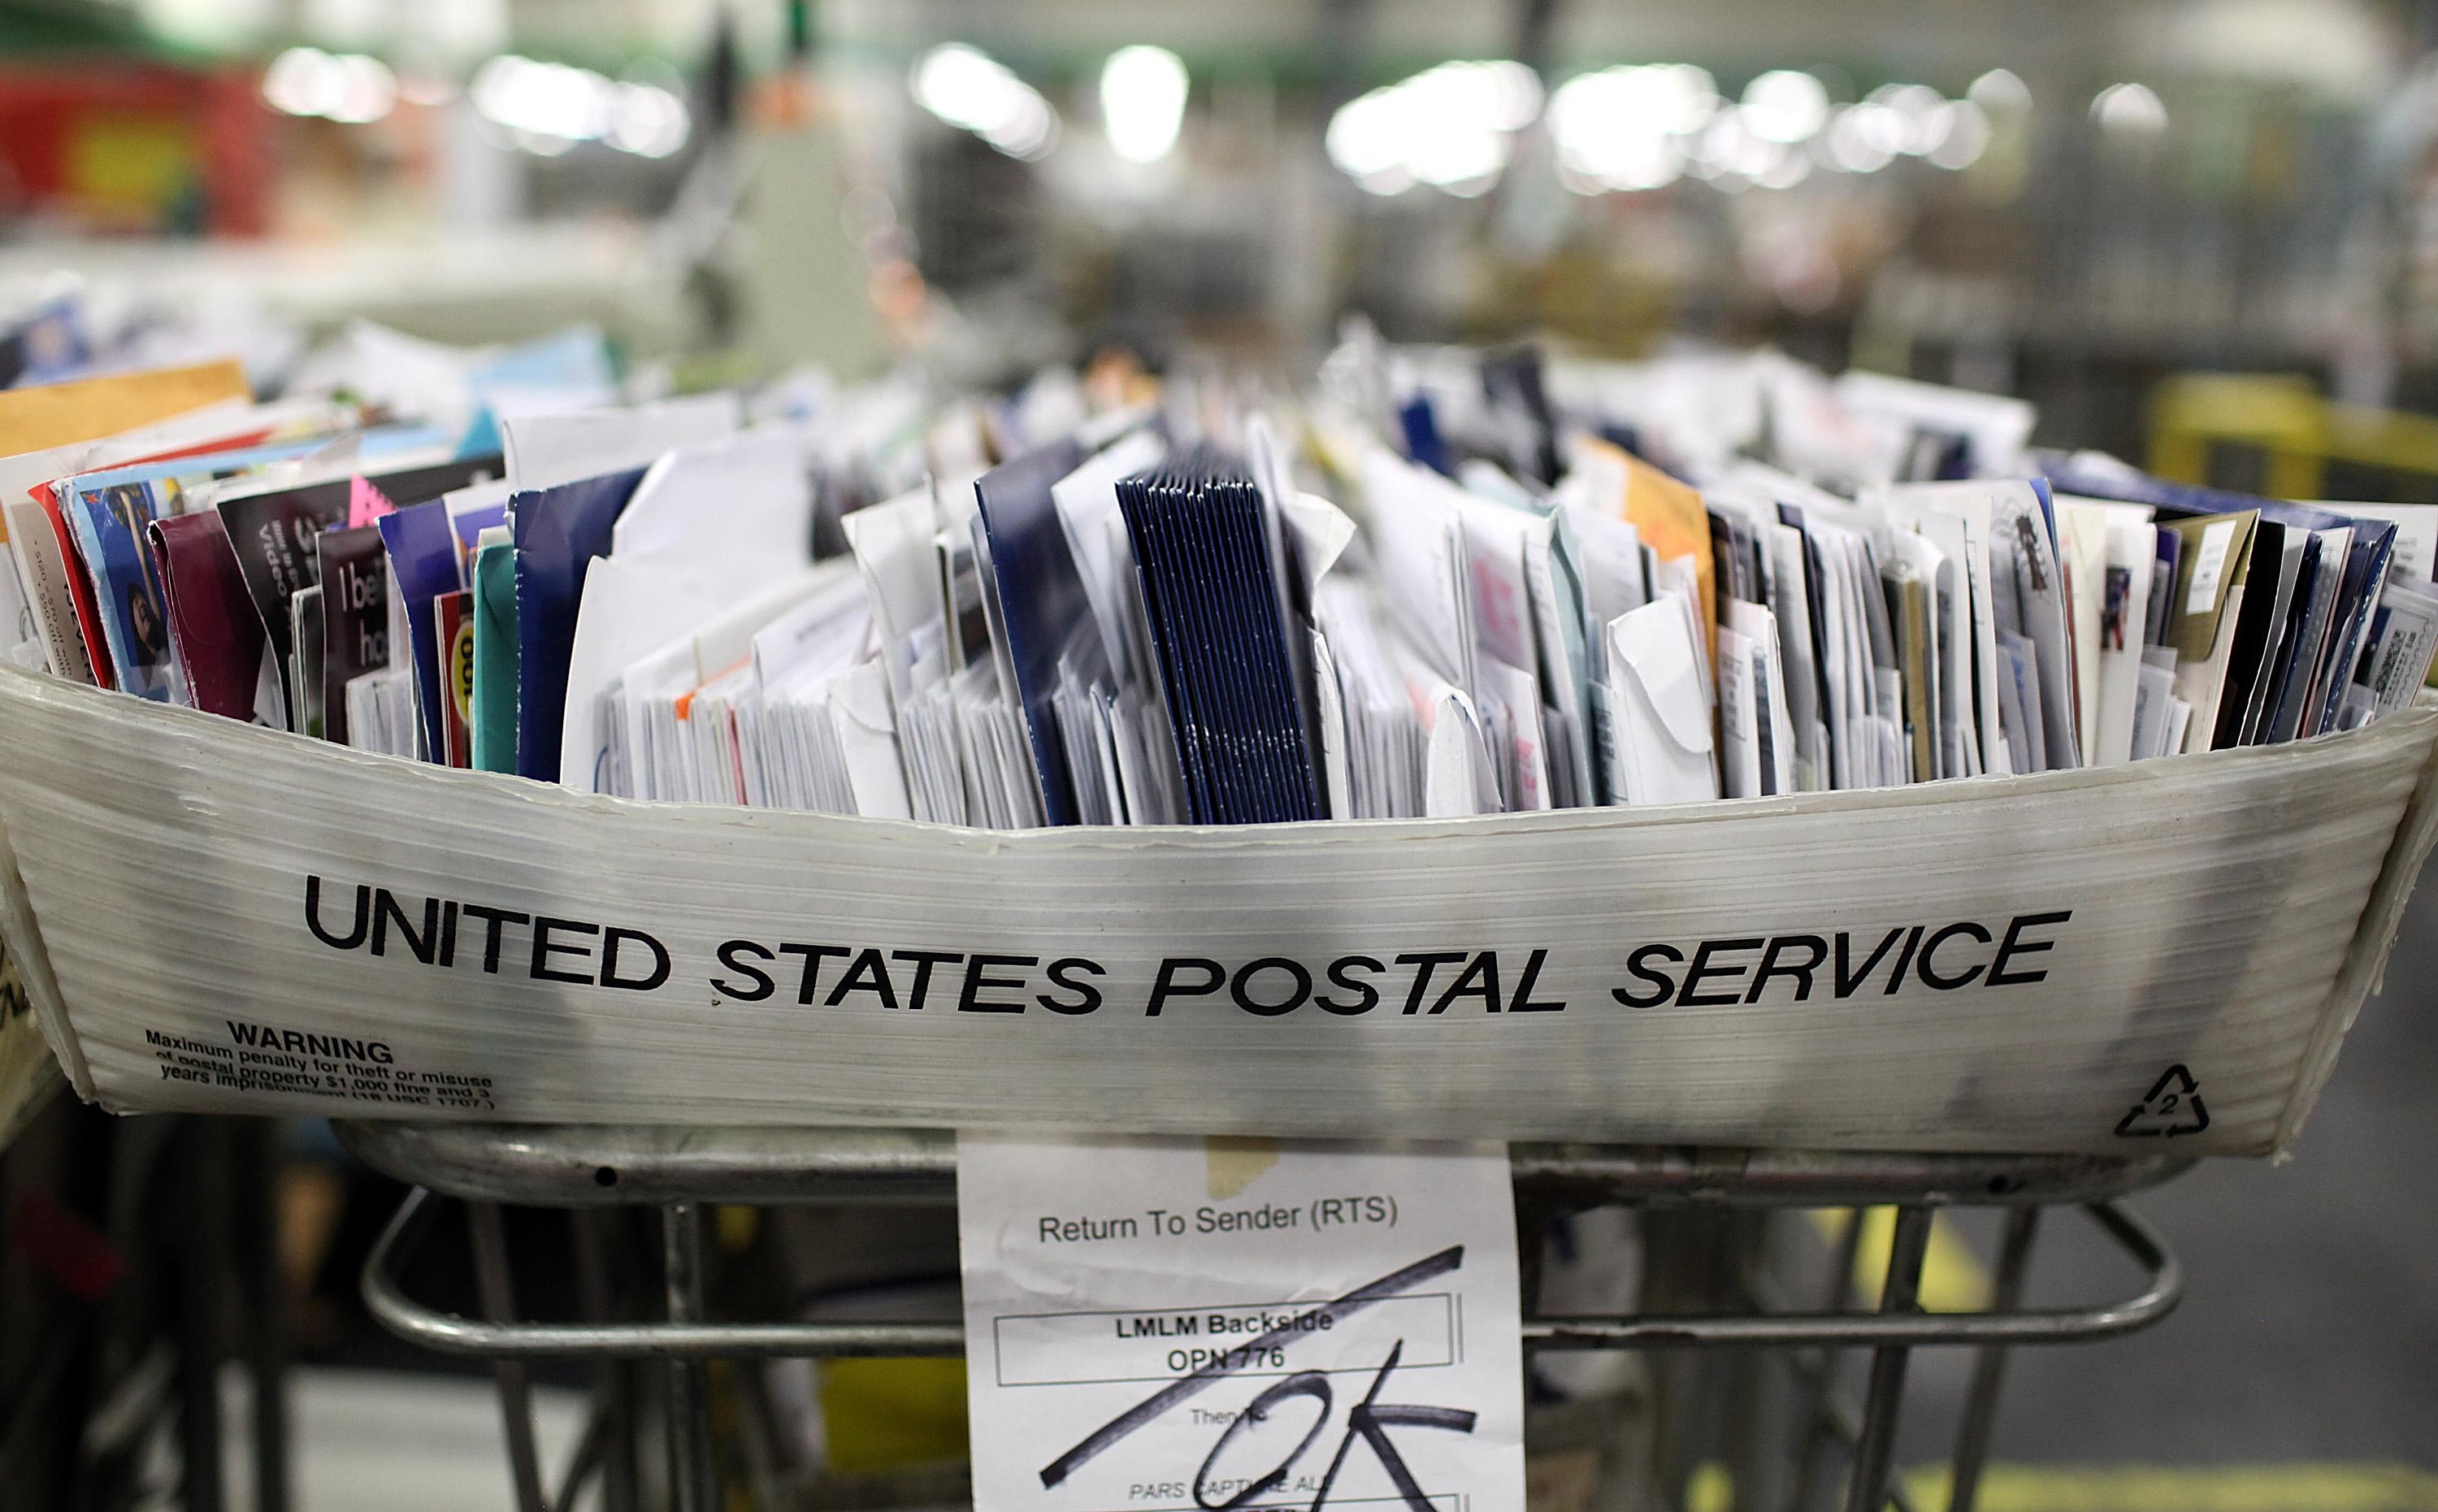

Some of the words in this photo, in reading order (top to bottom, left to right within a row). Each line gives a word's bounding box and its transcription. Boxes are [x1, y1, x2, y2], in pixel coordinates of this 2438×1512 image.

[306, 875, 671, 991] UNITED
[709, 939, 1107, 1016] STATES
[1145, 949, 1567, 1016] POSTAL
[1611, 910, 2072, 1008] SERVICE
[227, 1020, 393, 1064] WARNING
[145, 1029, 232, 1059] Maximum
[239, 1051, 307, 1072] penalty
[313, 1059, 340, 1073] for
[345, 1063, 390, 1079] theft
[396, 1070, 416, 1081] or
[422, 1072, 492, 1088] misuse
[161, 1064, 210, 1084] years
[239, 1068, 319, 1089] property
[2158, 1094, 2179, 1116] 2
[1039, 1216, 1138, 1242] Return
[1147, 1210, 1186, 1236] To
[1196, 1205, 1301, 1234] Sender
[1310, 1195, 1398, 1232] (RTS)
[1116, 1315, 1198, 1338] LMLM
[1208, 1310, 1334, 1334] Backside
[1168, 1350, 1228, 1371] OPN
[1237, 1346, 1285, 1368] 776
[1190, 1408, 1238, 1426] Then
[1194, 1338, 1477, 1512] OK
[1129, 1483, 1186, 1500] PARS
